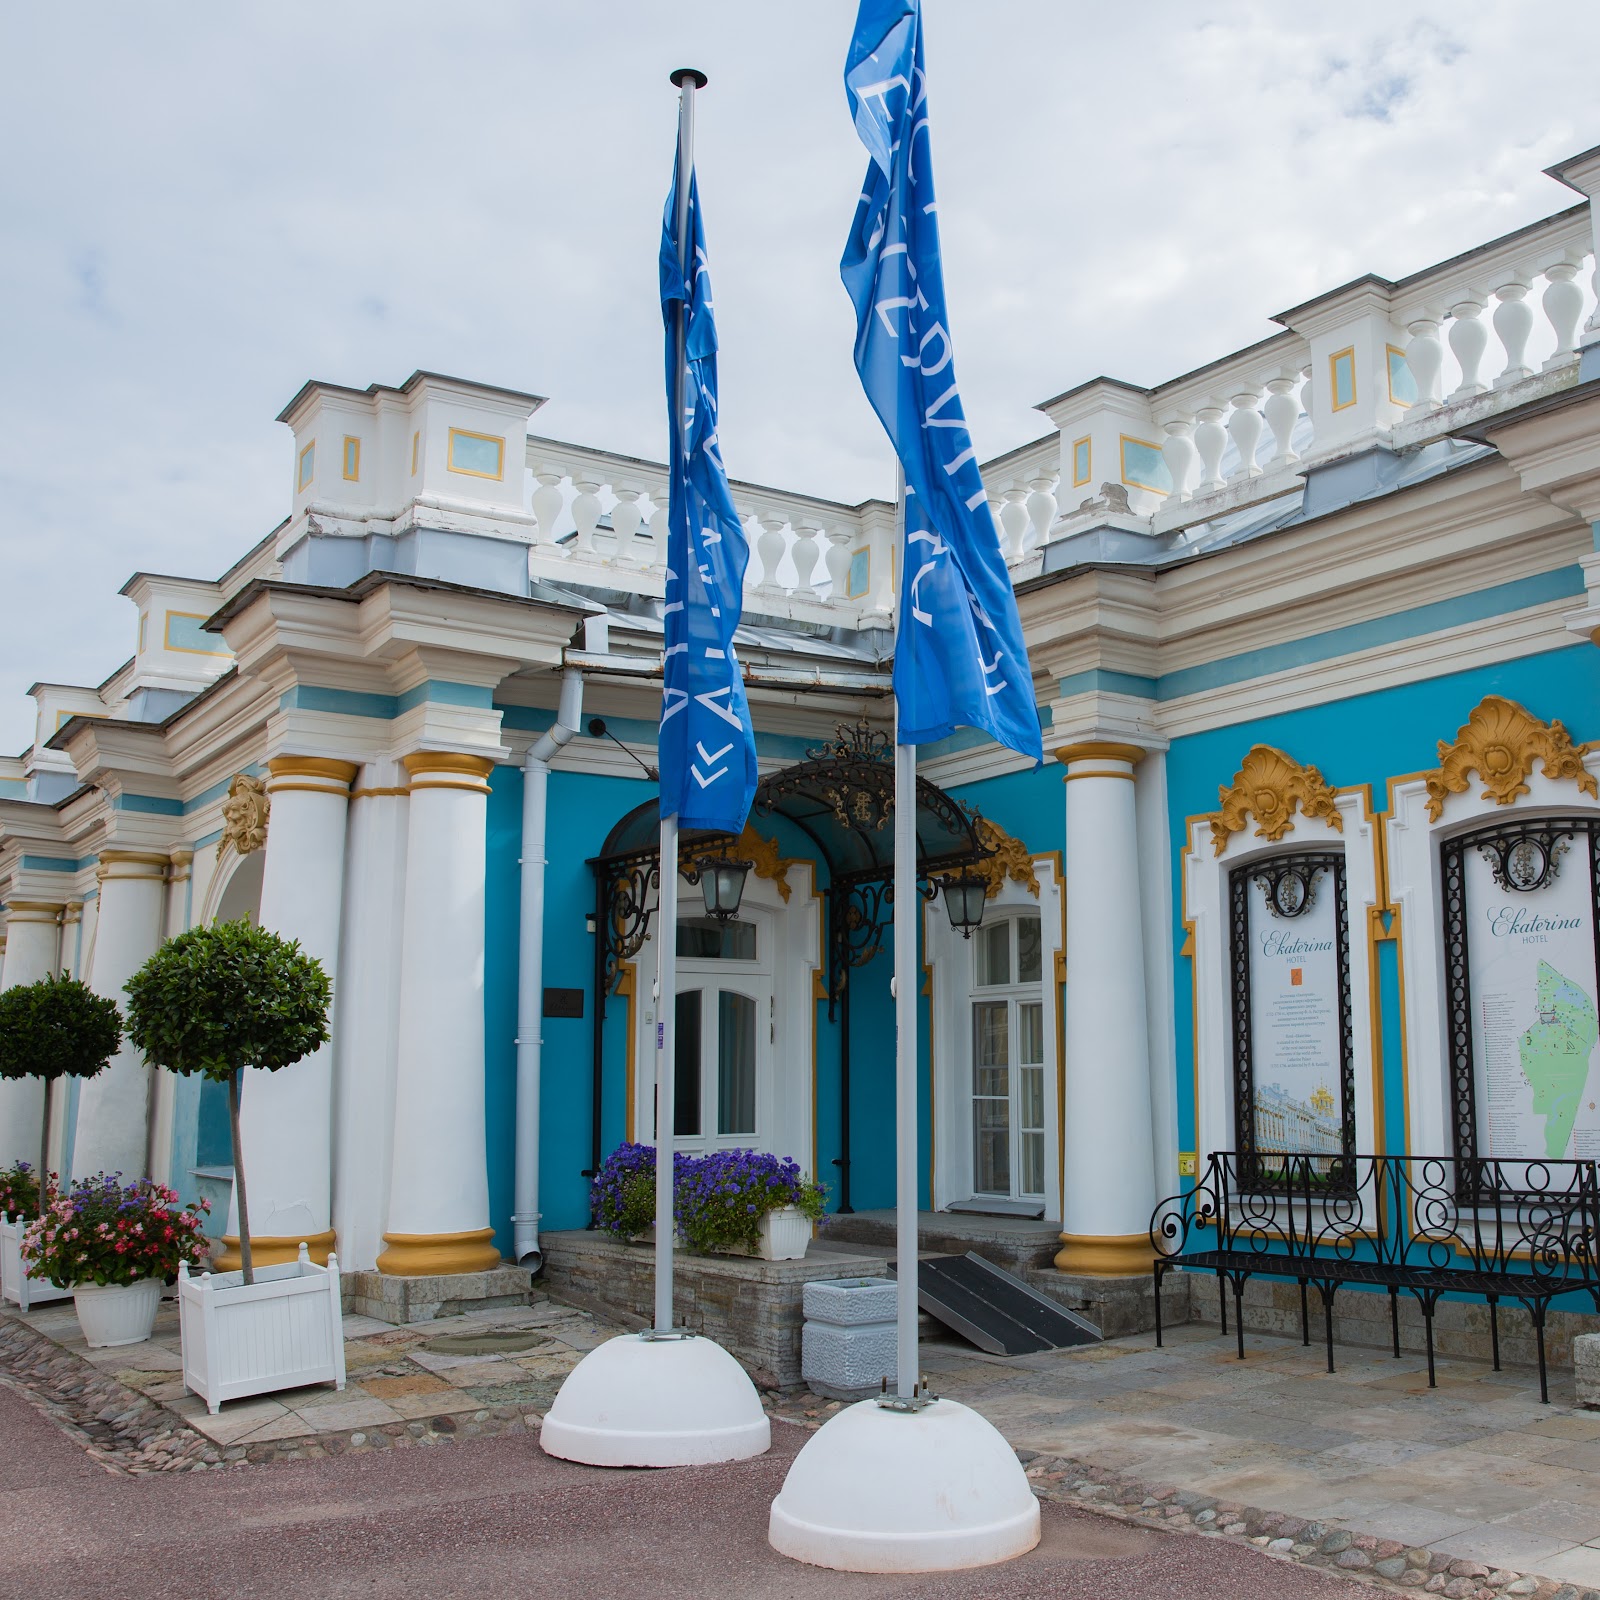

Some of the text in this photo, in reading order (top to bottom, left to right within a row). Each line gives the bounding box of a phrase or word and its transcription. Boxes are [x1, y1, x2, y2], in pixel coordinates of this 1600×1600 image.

[1487, 907, 1582, 937] Ekaterina
[1260, 929, 1333, 957] Ekaterina
[1522, 935, 1548, 944] HOTEL
[1286, 955, 1307, 963] HOTEL
